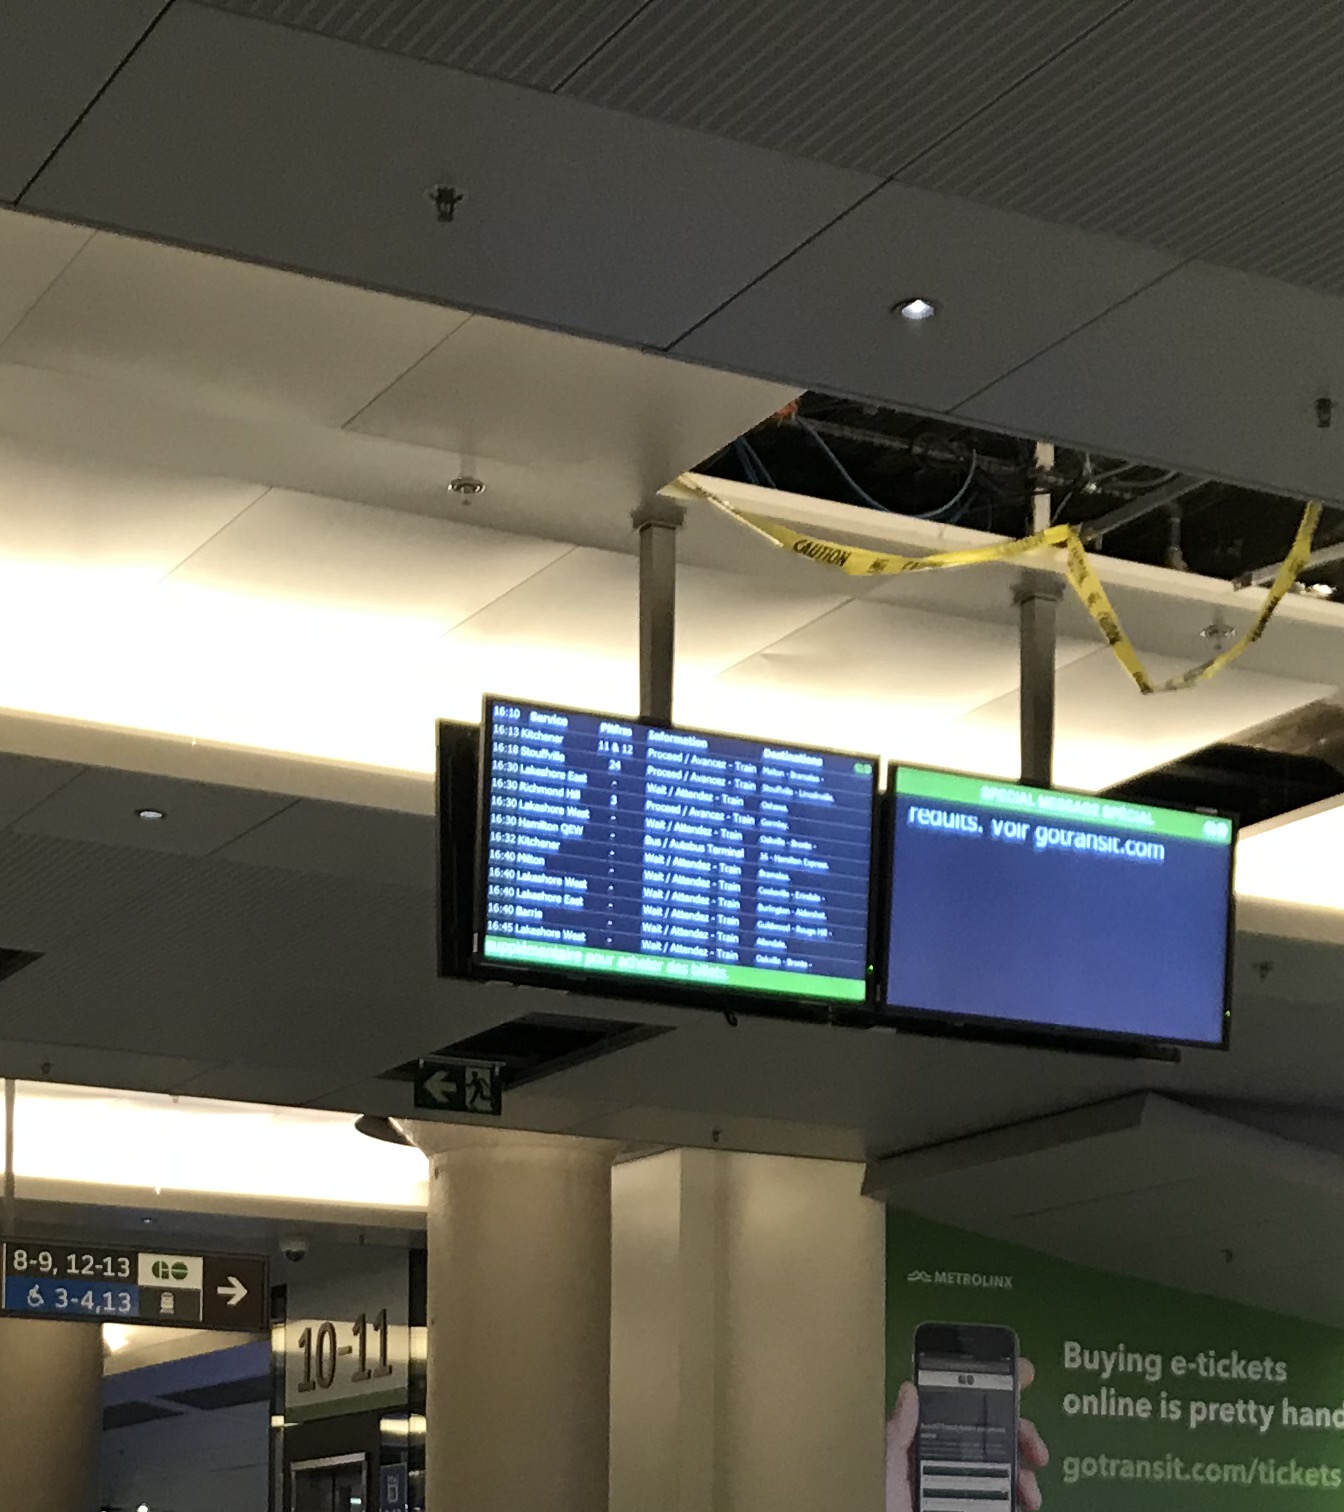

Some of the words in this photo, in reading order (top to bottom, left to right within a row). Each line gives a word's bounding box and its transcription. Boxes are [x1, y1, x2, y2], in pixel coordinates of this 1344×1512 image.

[793, 539, 852, 567] CAUTION
[493, 705, 520, 719] 16:10
[529, 710, 568, 727] Service
[492, 723, 519, 738] 16:13
[647, 729, 708, 748] Information
[492, 759, 518, 773] 16:30
[734, 761, 756, 773] Train
[491, 777, 518, 791] 16:30
[518, 781, 564, 797] Richmond
[734, 778, 756, 790] Train
[491, 795, 517, 808] 16:30
[721, 793, 743, 805] Train
[490, 813, 516, 826] 16:30
[732, 812, 755, 825] Train
[490, 831, 516, 844] 16:32
[720, 828, 742, 840] Train
[489, 848, 515, 862] 16:40
[488, 866, 515, 879] 16:40
[719, 862, 741, 874] Train
[488, 884, 514, 897] 16:40
[718, 879, 740, 892] Train
[488, 902, 514, 915] 16:40
[717, 896, 740, 908] Train
[487, 920, 513, 932] 16:45
[716, 913, 739, 926] Train
[716, 930, 739, 943] Train
[715, 948, 738, 960] Train
[13, 1249, 57, 1276] 8-9,
[67, 1253, 130, 1279] 12-13
[935, 1271, 1013, 1289] METROLINX
[55, 1287, 131, 1315] 3-4,13
[297, 1307, 393, 1393] 10-11
[1063, 1341, 1162, 1382] Buying
[1171, 1350, 1288, 1383] e-tickets
[1063, 1388, 1152, 1419] online
[1160, 1391, 1182, 1420] is
[1189, 1399, 1274, 1433] pretty
[1063, 1453, 1342, 1488] gotransit.com/tickets
